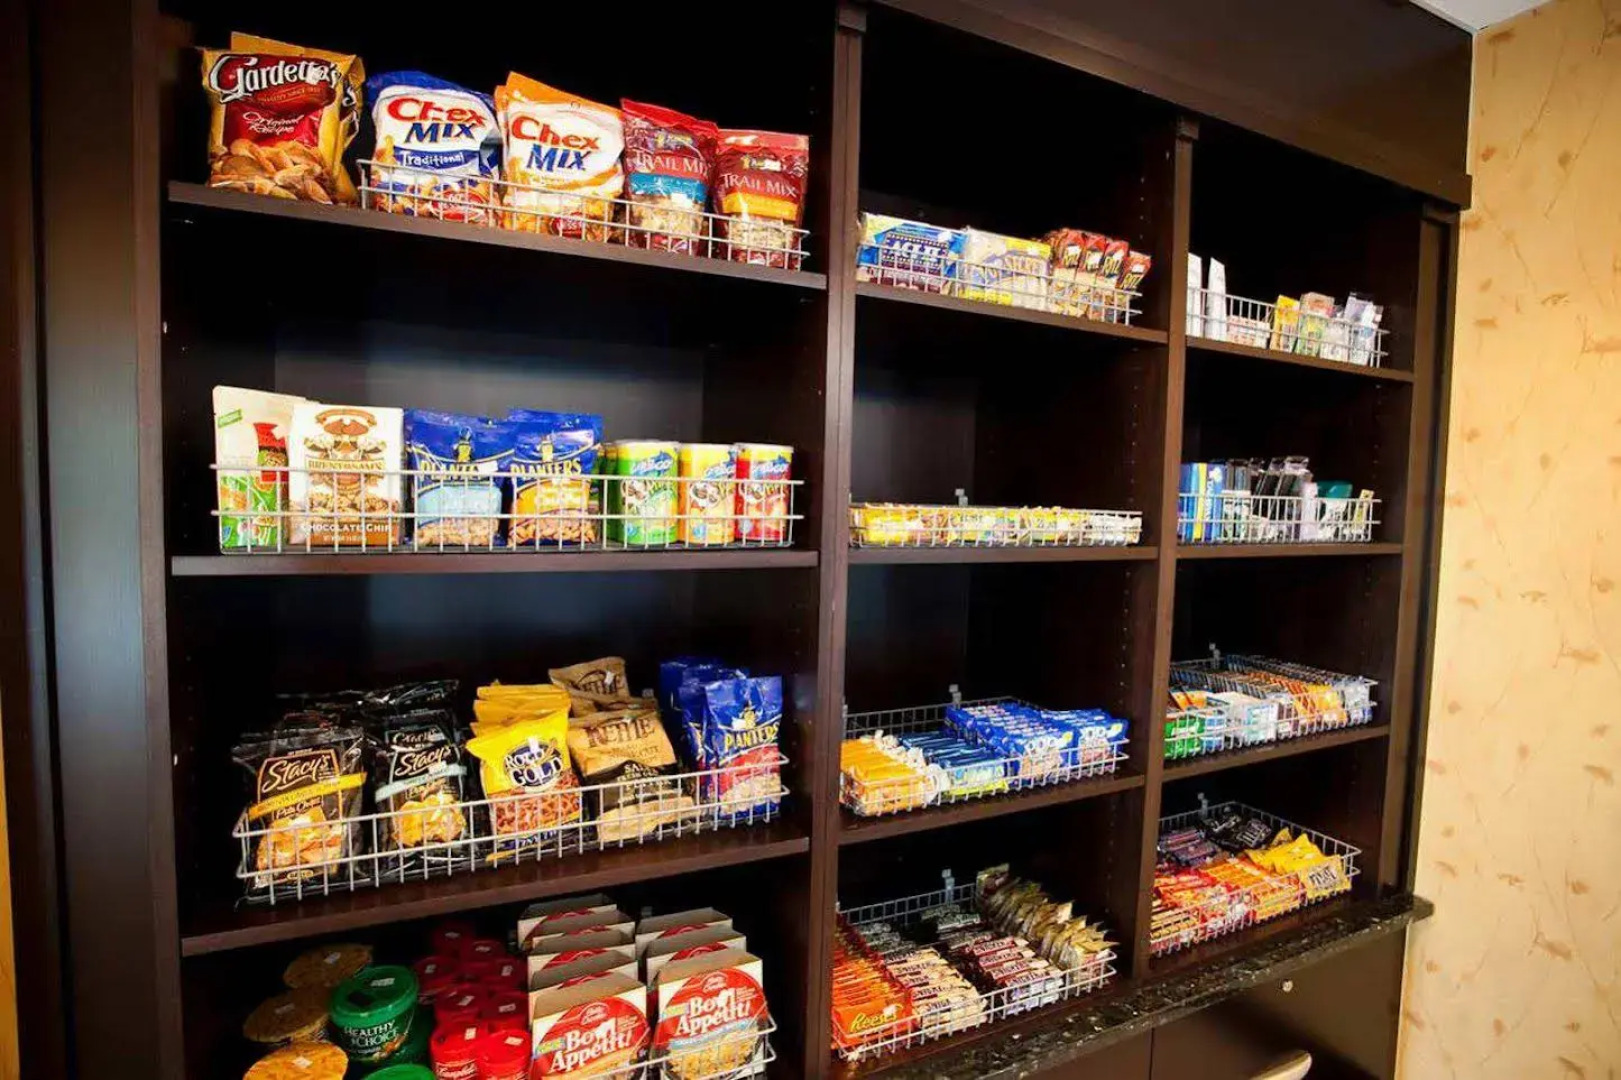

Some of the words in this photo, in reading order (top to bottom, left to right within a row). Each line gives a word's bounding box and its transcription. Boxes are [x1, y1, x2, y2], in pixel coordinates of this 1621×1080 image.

[387, 97, 486, 127] Chex
[511, 115, 600, 150] Chex
[400, 151, 465, 167] Traditional
[262, 755, 330, 793] Stacy's
[509, 757, 563, 787] GOLD
